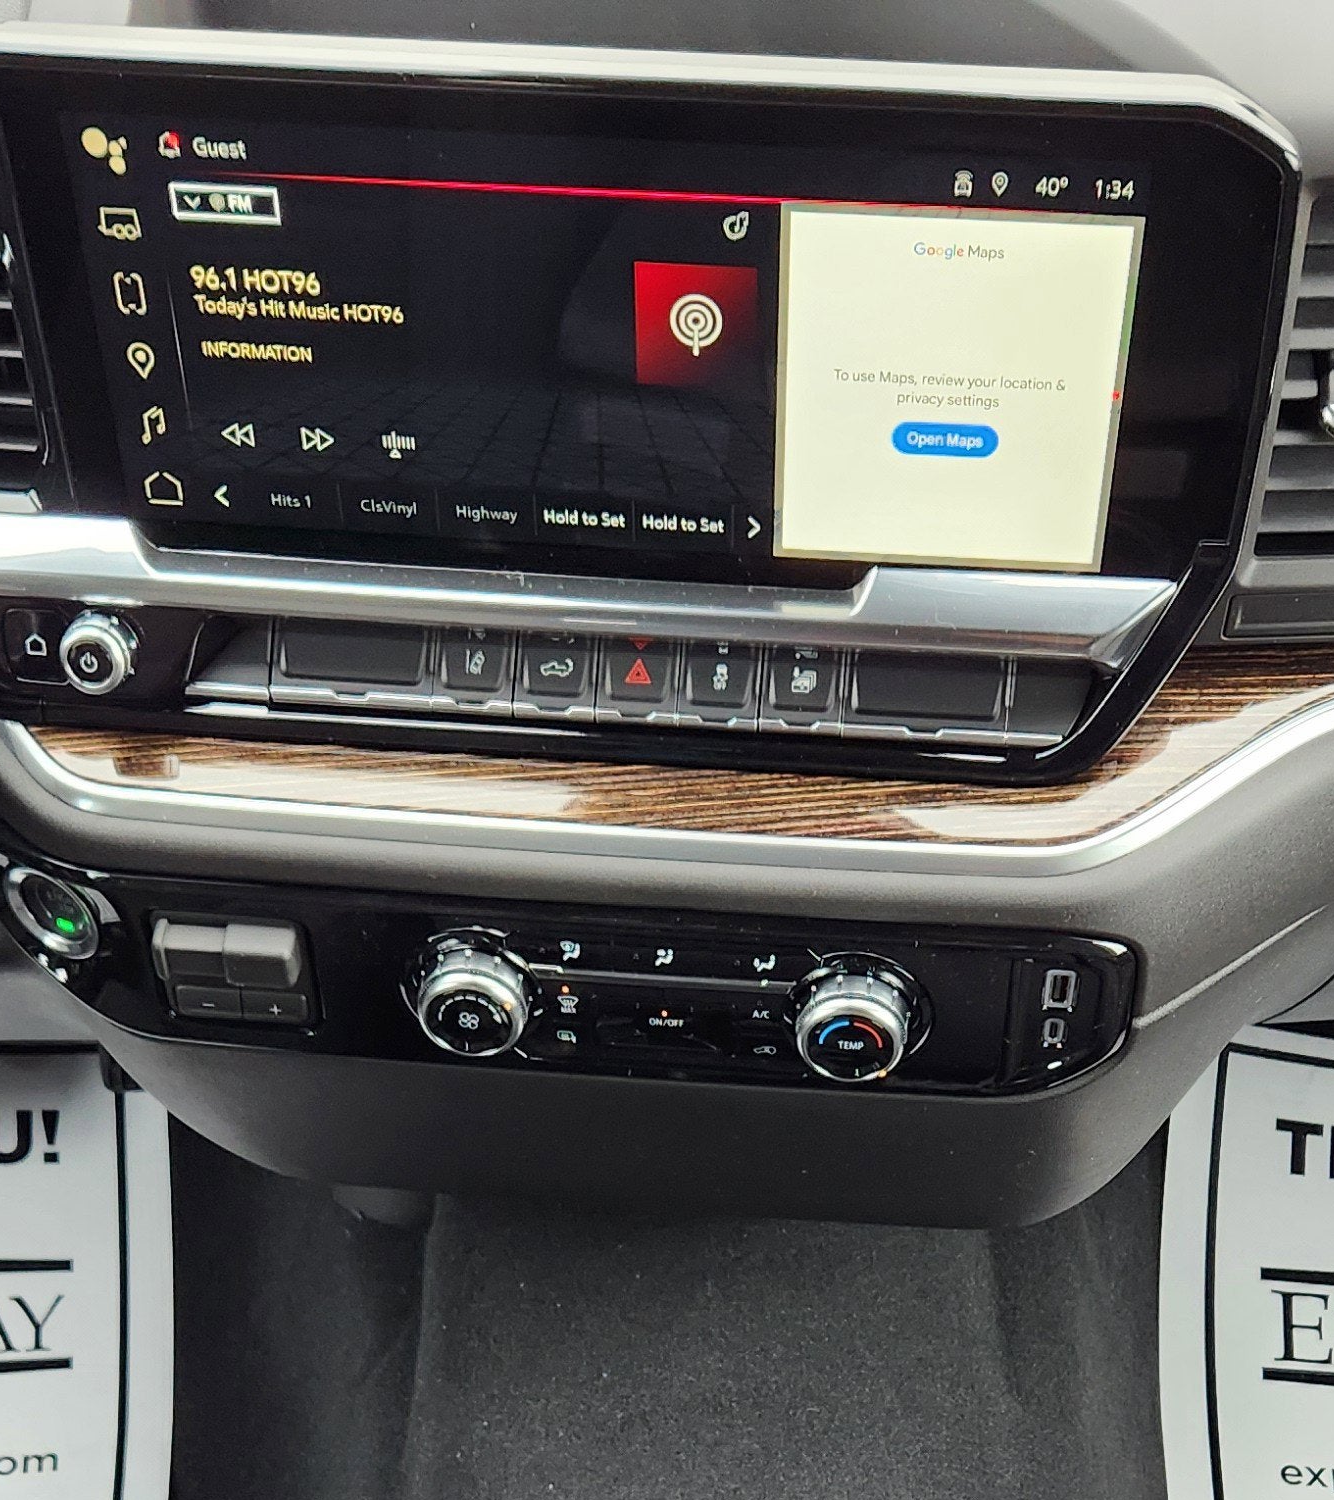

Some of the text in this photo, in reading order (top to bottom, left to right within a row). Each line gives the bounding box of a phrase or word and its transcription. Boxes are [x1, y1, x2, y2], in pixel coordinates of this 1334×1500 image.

[192, 137, 247, 160] Guest
[1095, 178, 1135, 201] 1:34
[227, 193, 253, 214] FM
[913, 242, 1005, 261] Google Maps
[189, 264, 321, 297] 96.1 HOT96
[193, 294, 405, 324] Today's Hit Music HOT96
[201, 340, 313, 363] INFORMATION
[834, 369, 1066, 392] To use Maps, review your location &
[896, 391, 1000, 409] privacy settings
[906, 431, 984, 450] Open Maps
[270, 493, 312, 508] Hits 1
[360, 499, 417, 519] ClsVinyl
[455, 505, 518, 525] Highway
[543, 508, 626, 528] Hold to Set
[641, 514, 725, 533] Hold to Set
[648, 1017, 684, 1028] ON/OFF
[752, 1009, 770, 1019] A/C
[838, 1040, 864, 1050] TEMP
